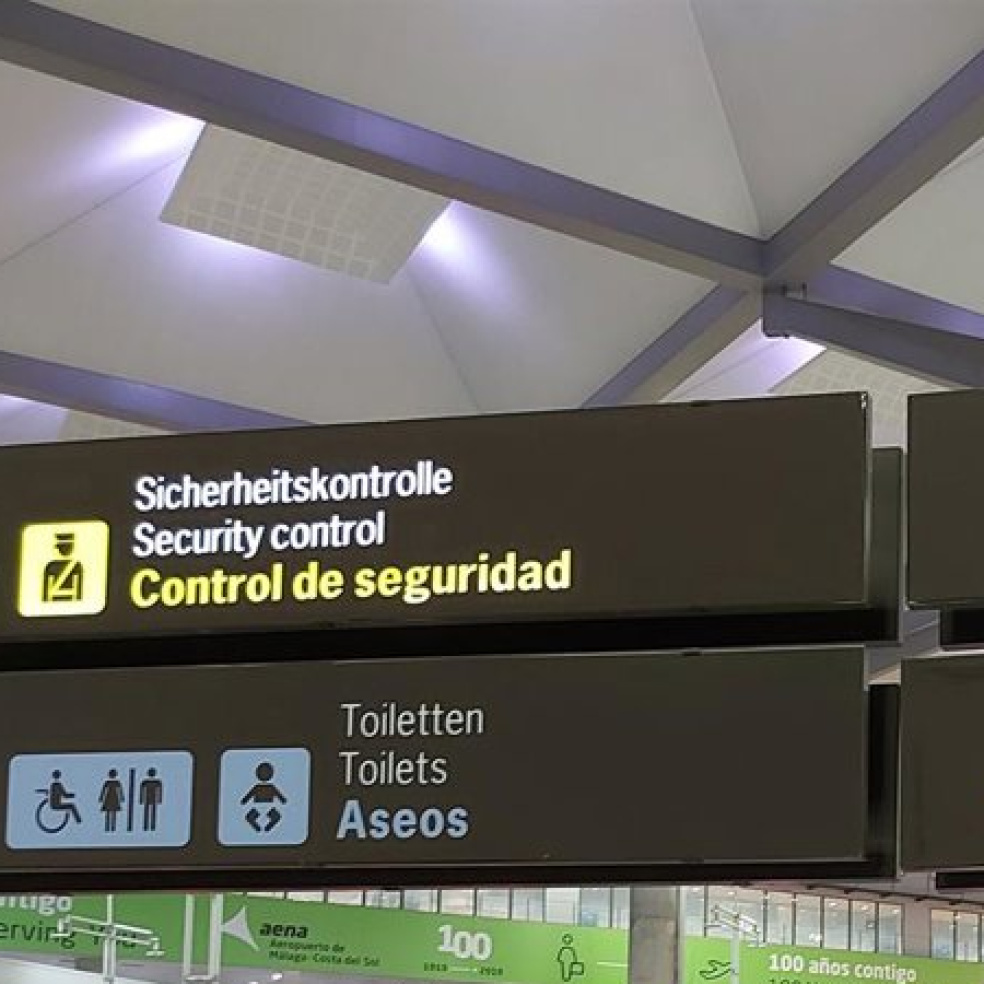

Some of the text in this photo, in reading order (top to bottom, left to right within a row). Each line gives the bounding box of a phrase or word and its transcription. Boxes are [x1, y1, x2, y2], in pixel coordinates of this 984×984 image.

[134, 459, 453, 512] Sicherheitskontrolle
[132, 510, 386, 559] Security control
[130, 548, 572, 609] Control de seguridad
[340, 702, 484, 738] Toiletten
[338, 750, 447, 786] Toilets
[336, 799, 469, 839] Aseos
[260, 922, 309, 939] aena
[438, 924, 493, 961] 100
[769, 953, 917, 984] 100 años contigo
